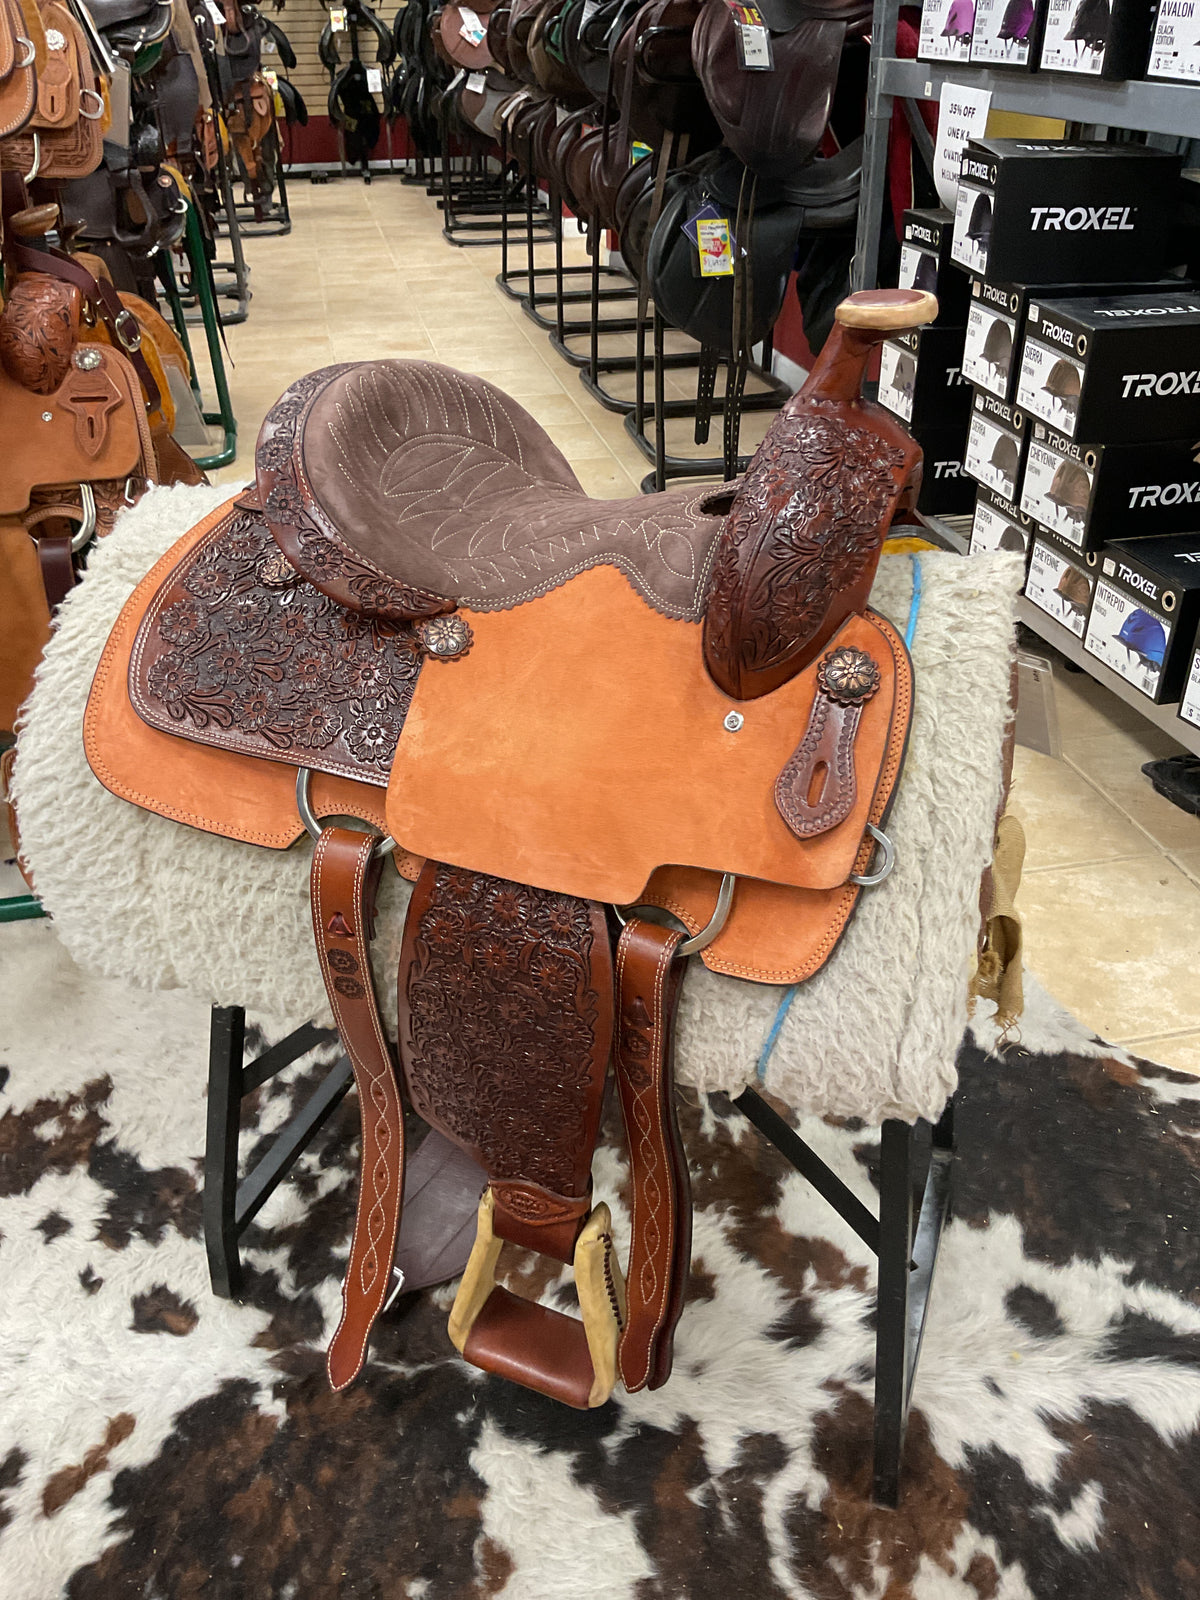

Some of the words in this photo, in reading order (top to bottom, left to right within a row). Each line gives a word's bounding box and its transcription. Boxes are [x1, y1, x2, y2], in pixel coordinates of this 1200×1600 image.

[1160, 1, 1195, 18] AVALON
[1155, 35, 1175, 46] EDITION
[1157, 25, 1174, 35] BLACK
[963, 105, 976, 119] OFF
[947, 126, 960, 140] ONE
[943, 148, 963, 163] OVATIO
[969, 160, 990, 181] TROXEL
[1030, 206, 1135, 231] TROXEL
[911, 223, 932, 243] TROXEL
[982, 284, 1008, 307] TROXEL
[1041, 320, 1074, 348] TROXEL
[1024, 345, 1043, 365] SIERRA
[985, 396, 1011, 422] TROXEL
[1047, 431, 1081, 461] TROXEL
[1030, 446, 1057, 470] CHEYENNE
[990, 491, 1018, 518] TROXEL
[1034, 546, 1060, 572] CHEYENNE
[1118, 563, 1158, 601] TROXEL
[1096, 584, 1125, 613] INTREPID
